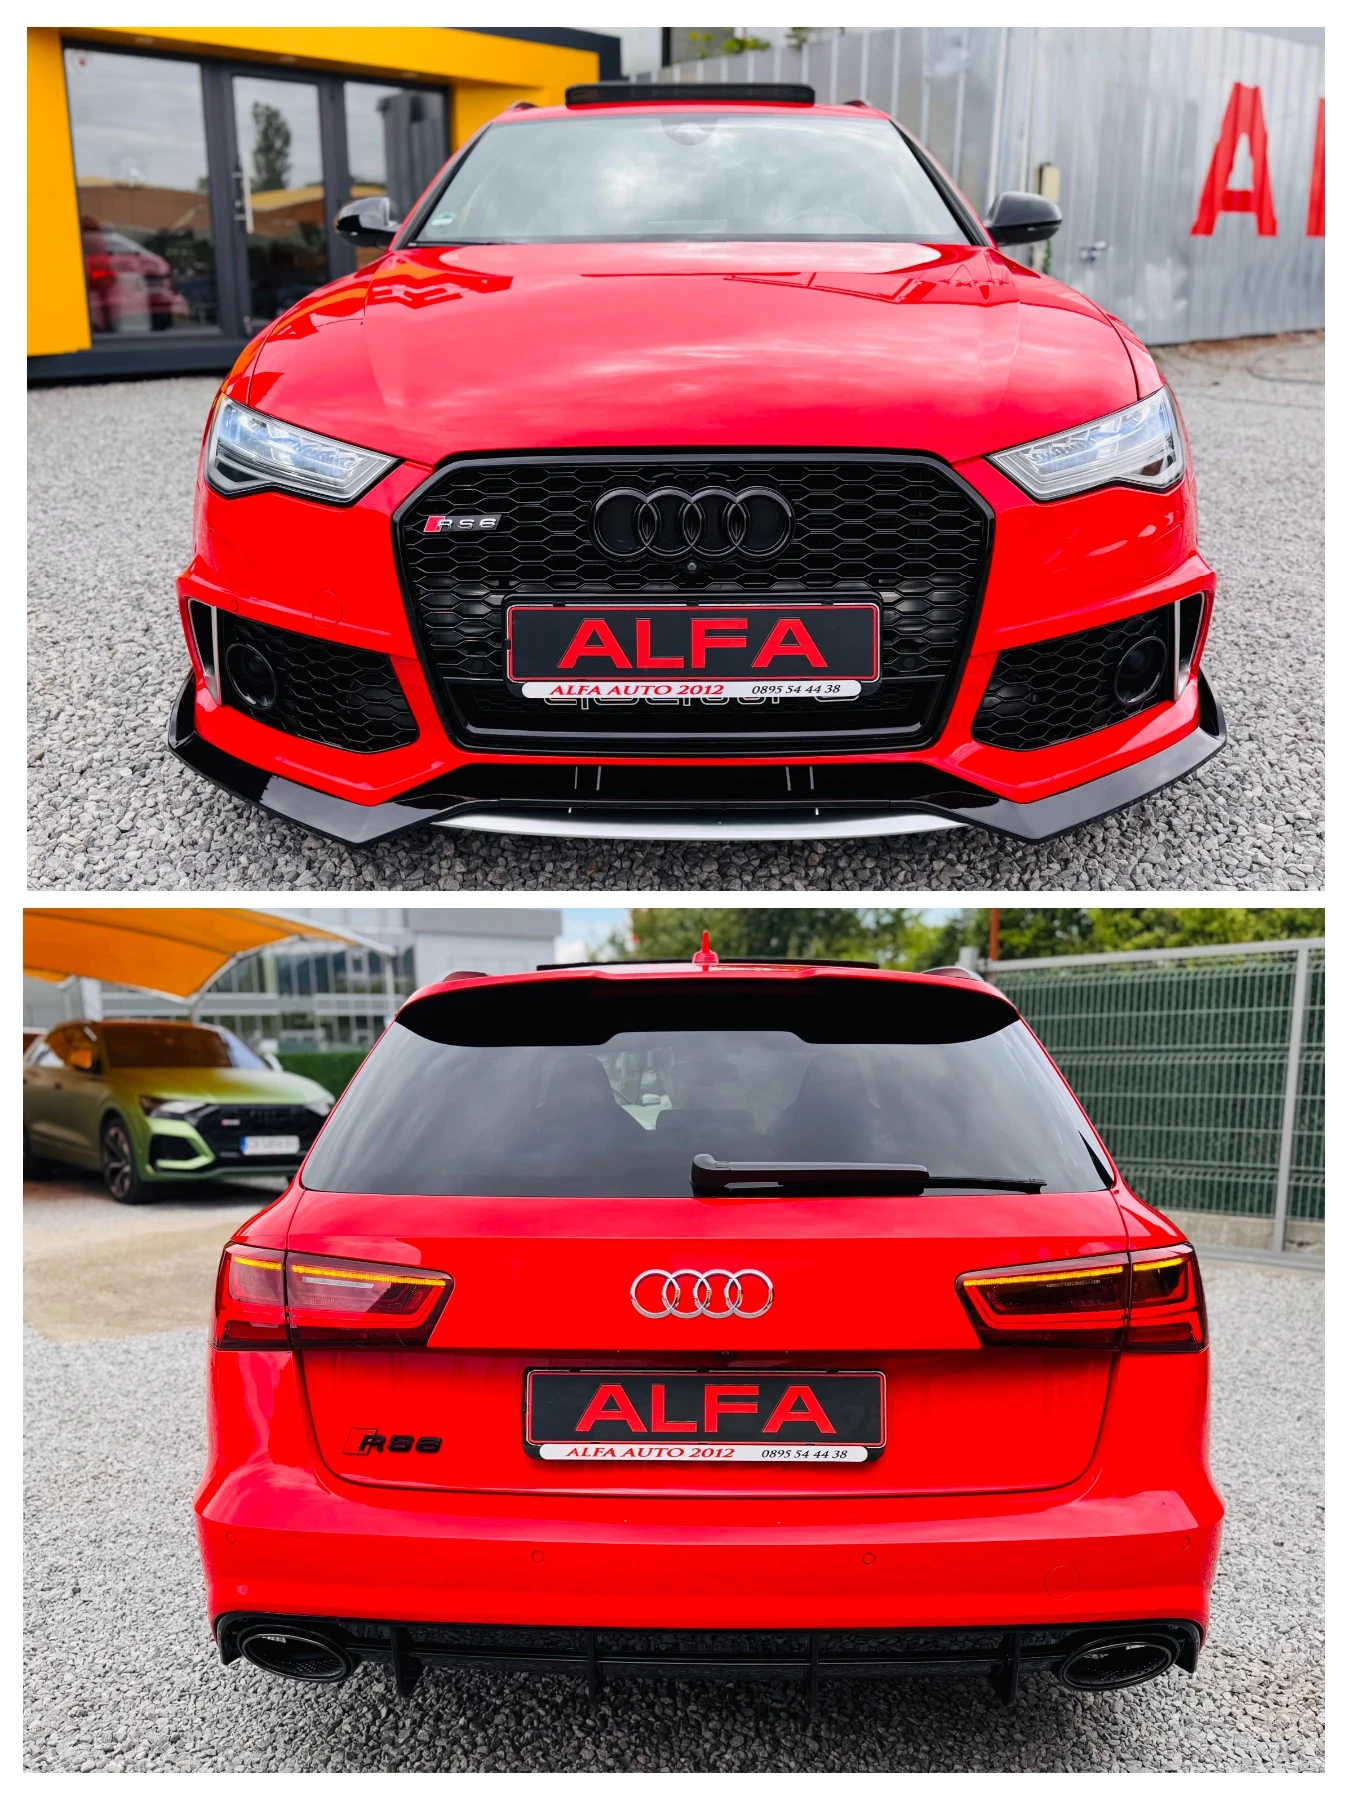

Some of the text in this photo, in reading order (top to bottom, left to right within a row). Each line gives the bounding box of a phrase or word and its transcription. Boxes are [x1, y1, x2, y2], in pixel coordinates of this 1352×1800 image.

[436, 518, 497, 530] RS6
[557, 617, 828, 669] ALFA
[548, 684, 841, 695] ALFA AUTO 2012 0895 54 44 38
[574, 1382, 837, 1434] ALFA
[358, 1434, 442, 1453] RS6
[565, 1447, 848, 1459] ALFA AUTO 2012 0895 54 44 38
